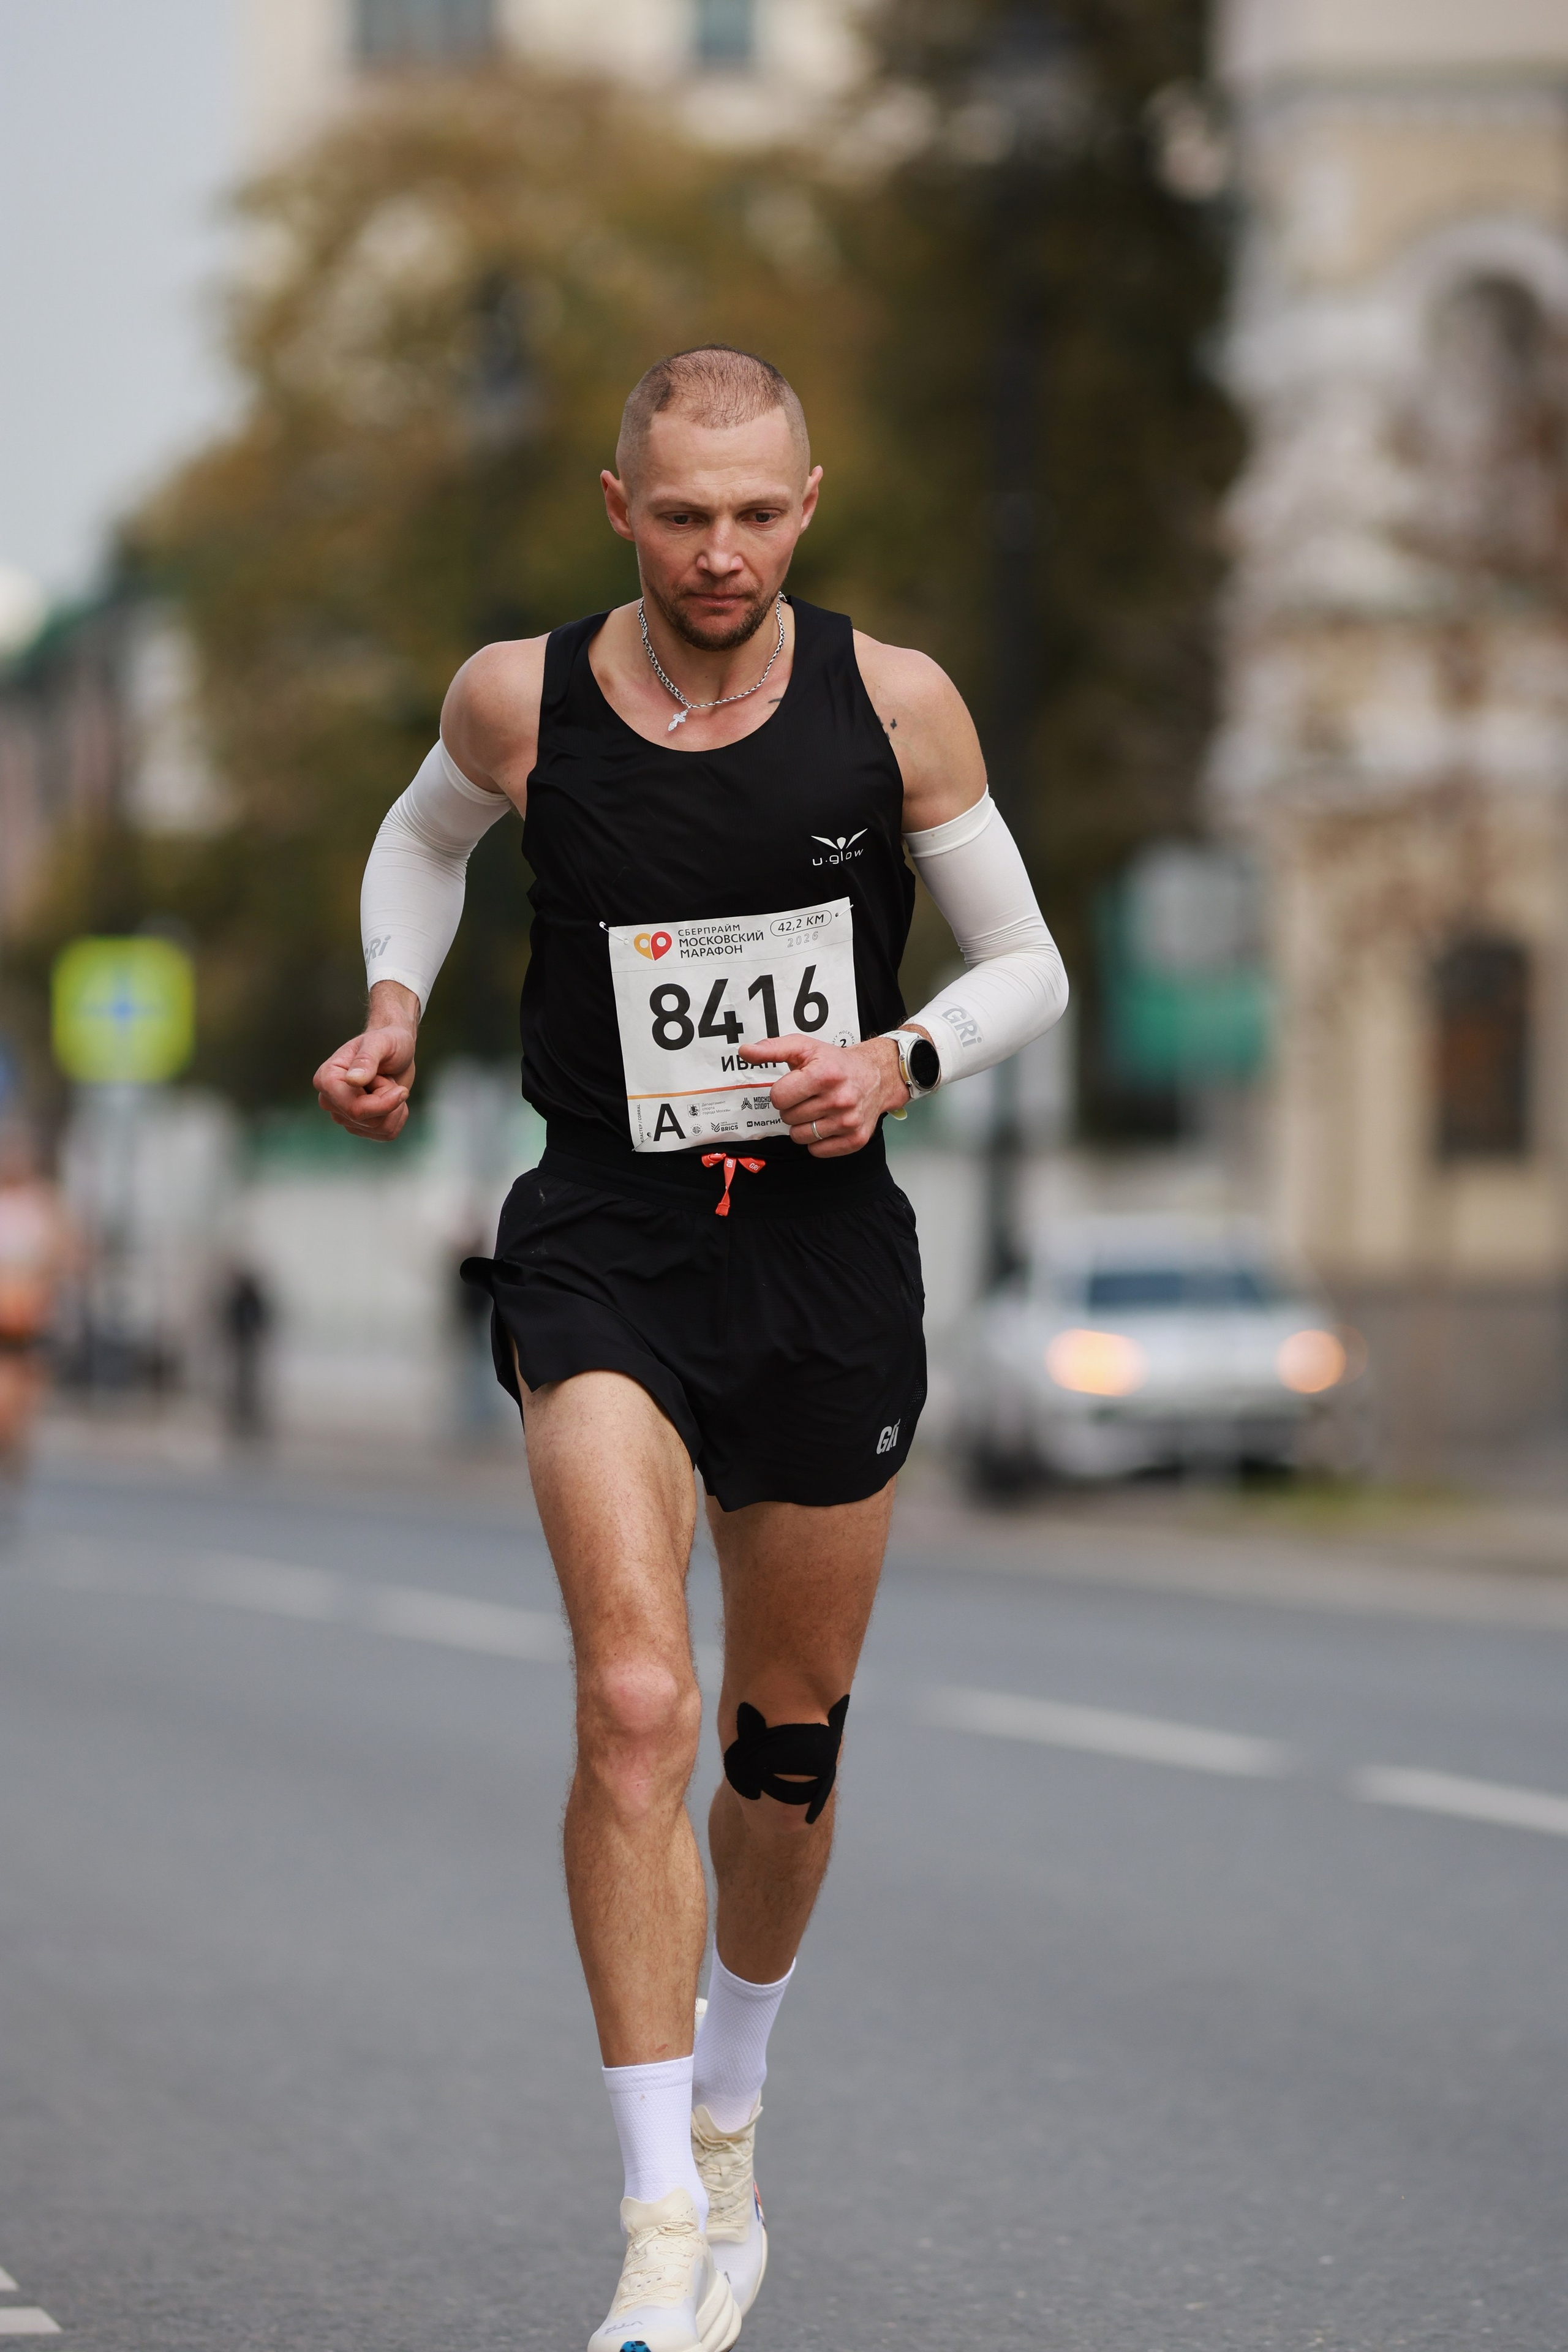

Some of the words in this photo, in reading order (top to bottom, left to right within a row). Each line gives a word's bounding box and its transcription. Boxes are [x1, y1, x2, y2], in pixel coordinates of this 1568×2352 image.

[678, 924, 741, 937] СБЕРПРАЙМ
[778, 919, 802, 932] 42,2
[679, 930, 764, 948] МОСКОВСКИЙ
[787, 931, 818, 948] 2026
[680, 944, 743, 959] МАРАФОН
[649, 964, 829, 1050] 8416
[839, 1038, 847, 1048] 2
